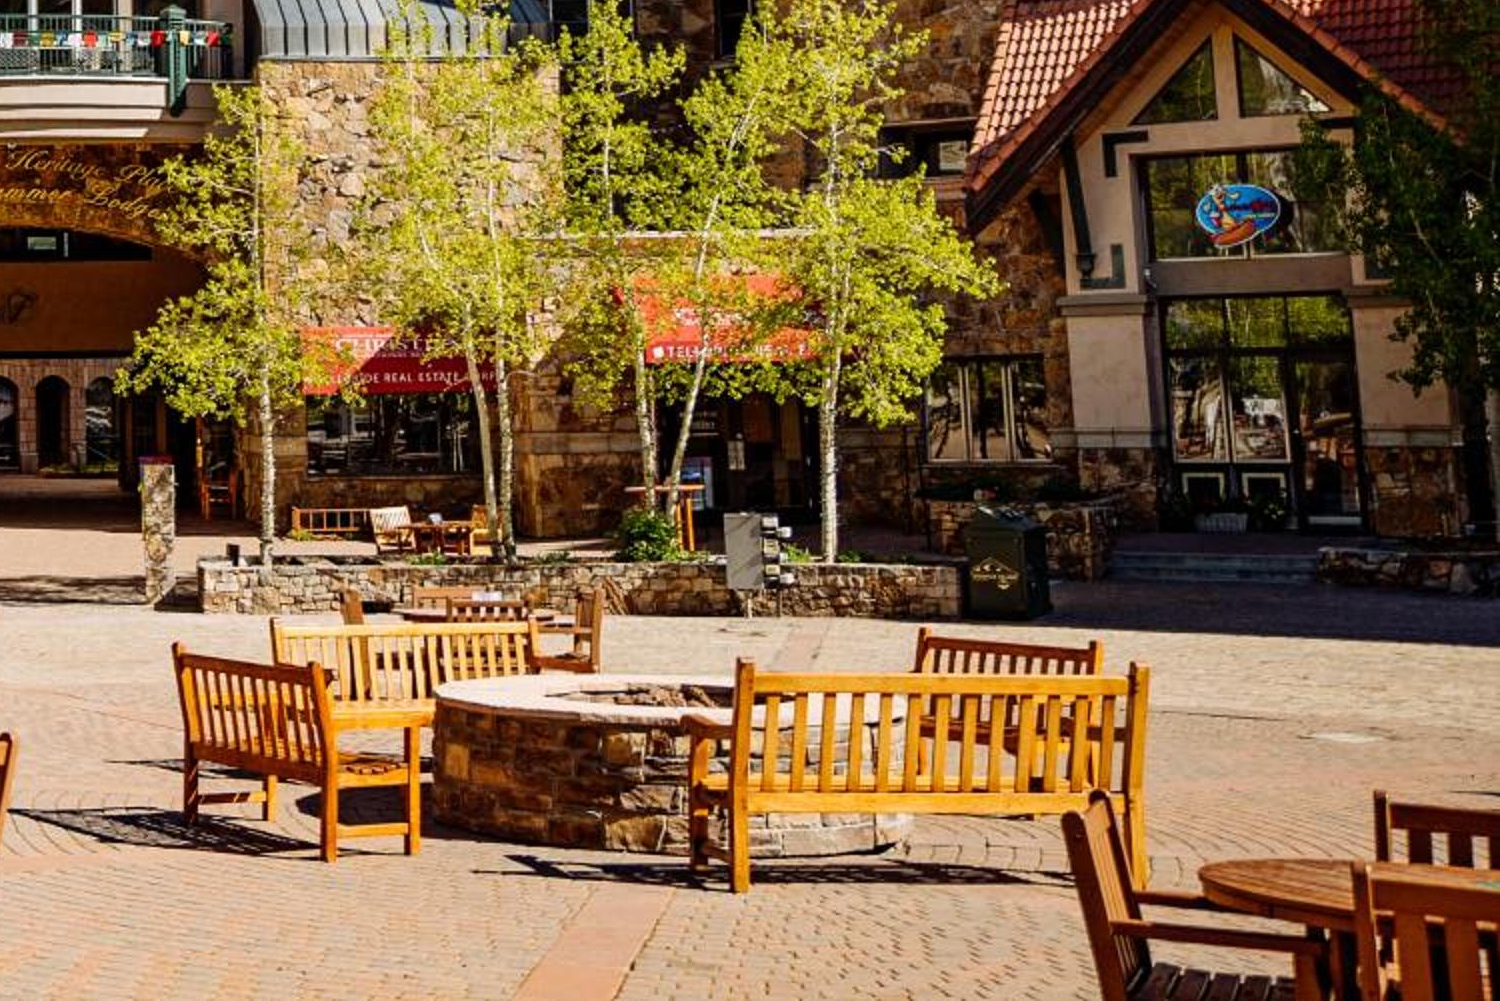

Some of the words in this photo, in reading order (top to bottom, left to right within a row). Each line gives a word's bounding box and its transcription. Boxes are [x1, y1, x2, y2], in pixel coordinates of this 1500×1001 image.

[4, 149, 107, 180] Heritage
[383, 372, 413, 384] REAL
[417, 371, 460, 384] ESTATE
